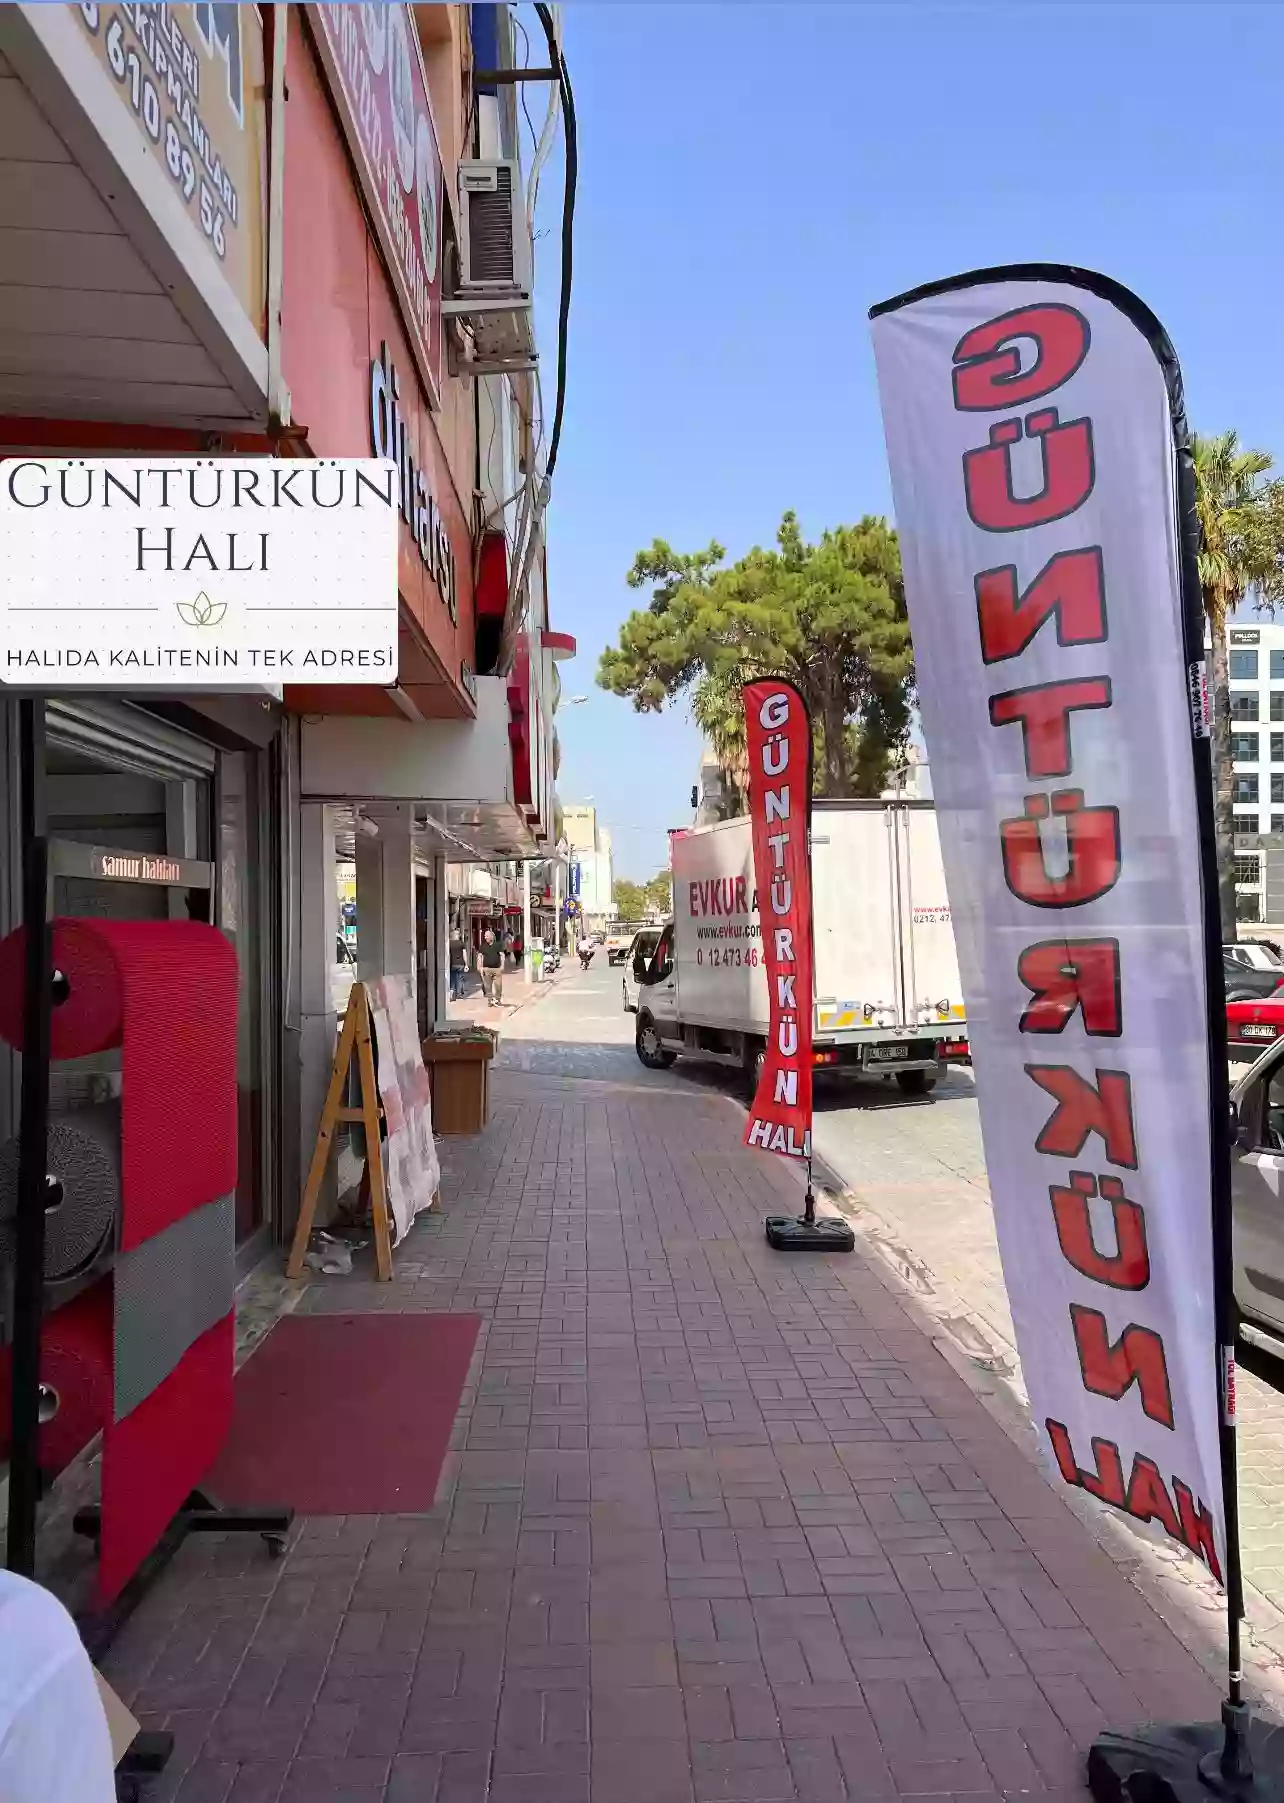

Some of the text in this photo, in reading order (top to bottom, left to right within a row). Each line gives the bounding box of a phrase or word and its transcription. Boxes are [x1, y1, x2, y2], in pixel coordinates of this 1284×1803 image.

[150, 3, 199, 98] LERİ
[107, 20, 225, 258] 610 89 56
[101, 855, 140, 878] samur
[689, 875, 749, 917] EVKUR
[758, 692, 799, 1106] GÜNTÜRKÜN
[748, 1118, 813, 1158] HALI
